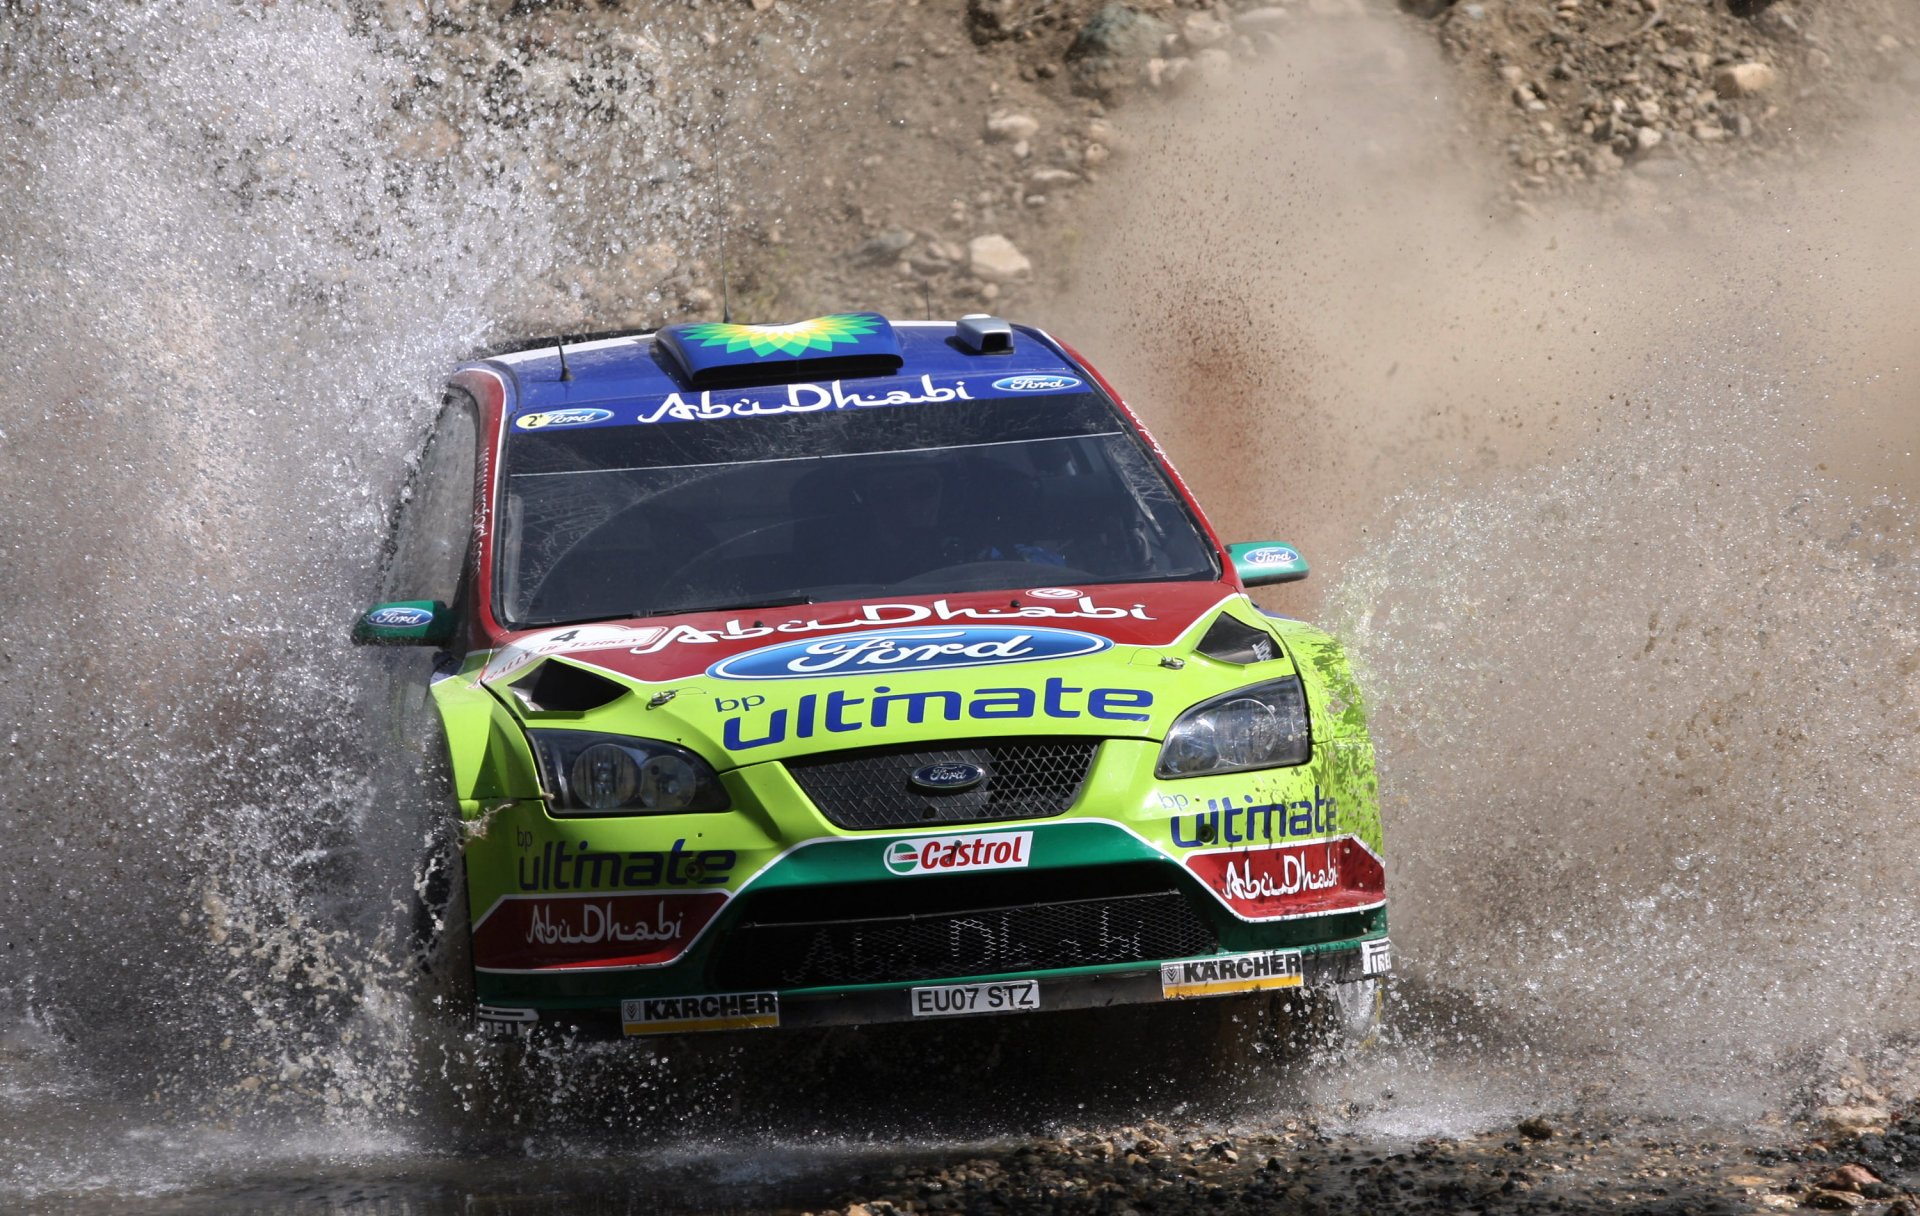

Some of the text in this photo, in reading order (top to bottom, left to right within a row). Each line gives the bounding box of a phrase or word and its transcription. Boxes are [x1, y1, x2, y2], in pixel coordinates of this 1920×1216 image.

[1009, 376, 1065, 390] Ford
[545, 411, 598, 424] Ford
[1255, 548, 1292, 563] Ford
[376, 608, 423, 625] Ford
[550, 629, 581, 643] 4
[787, 630, 1035, 672] Ford
[715, 694, 766, 713] bp
[723, 677, 1155, 751] ultimate
[929, 765, 967, 781] Ford
[1157, 792, 1189, 811] bp
[1170, 784, 1337, 848] ultimate
[517, 826, 533, 850] bp
[920, 836, 1023, 870] Castrol
[519, 838, 737, 891] ultimate
[918, 983, 1034, 1012] EU07 STZ
